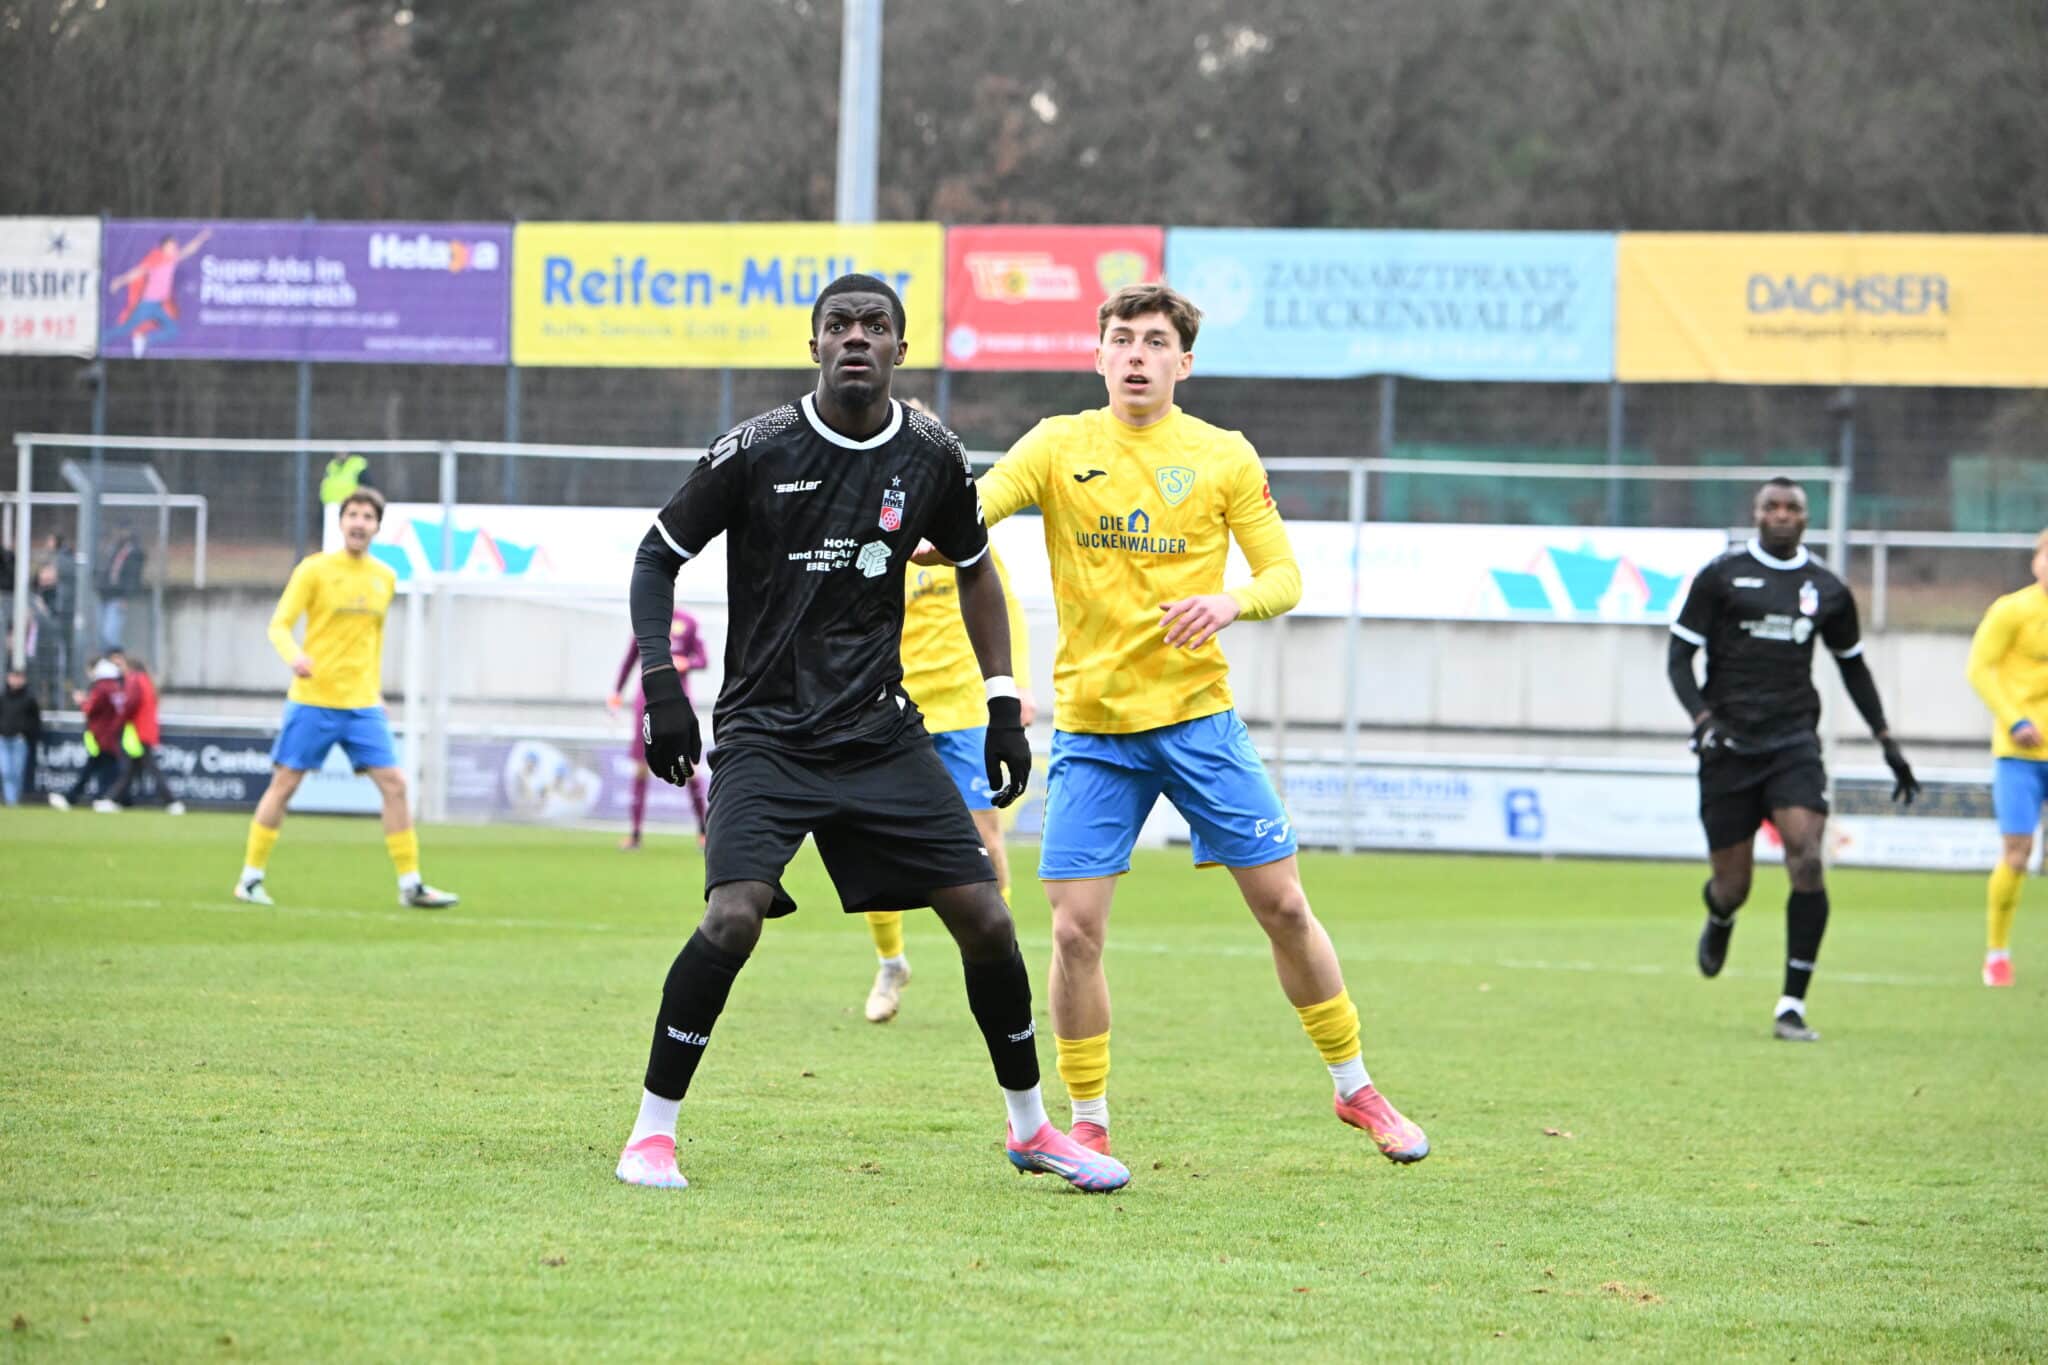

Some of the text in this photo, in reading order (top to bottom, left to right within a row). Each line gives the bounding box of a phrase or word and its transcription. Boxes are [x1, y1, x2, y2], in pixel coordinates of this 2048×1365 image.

[543, 256, 911, 309] Reifen-Mülr
[1747, 273, 1949, 316] DACHSER
[1160, 469, 1191, 493] FSV
[884, 497, 903, 509] RWE
[889, 491, 901, 500] FC
[1100, 515, 1124, 531] DIE
[1076, 532, 1186, 553] LUCKENWALDER
[788, 549, 855, 560] und TIEFAU
[201, 744, 273, 775] Cente
